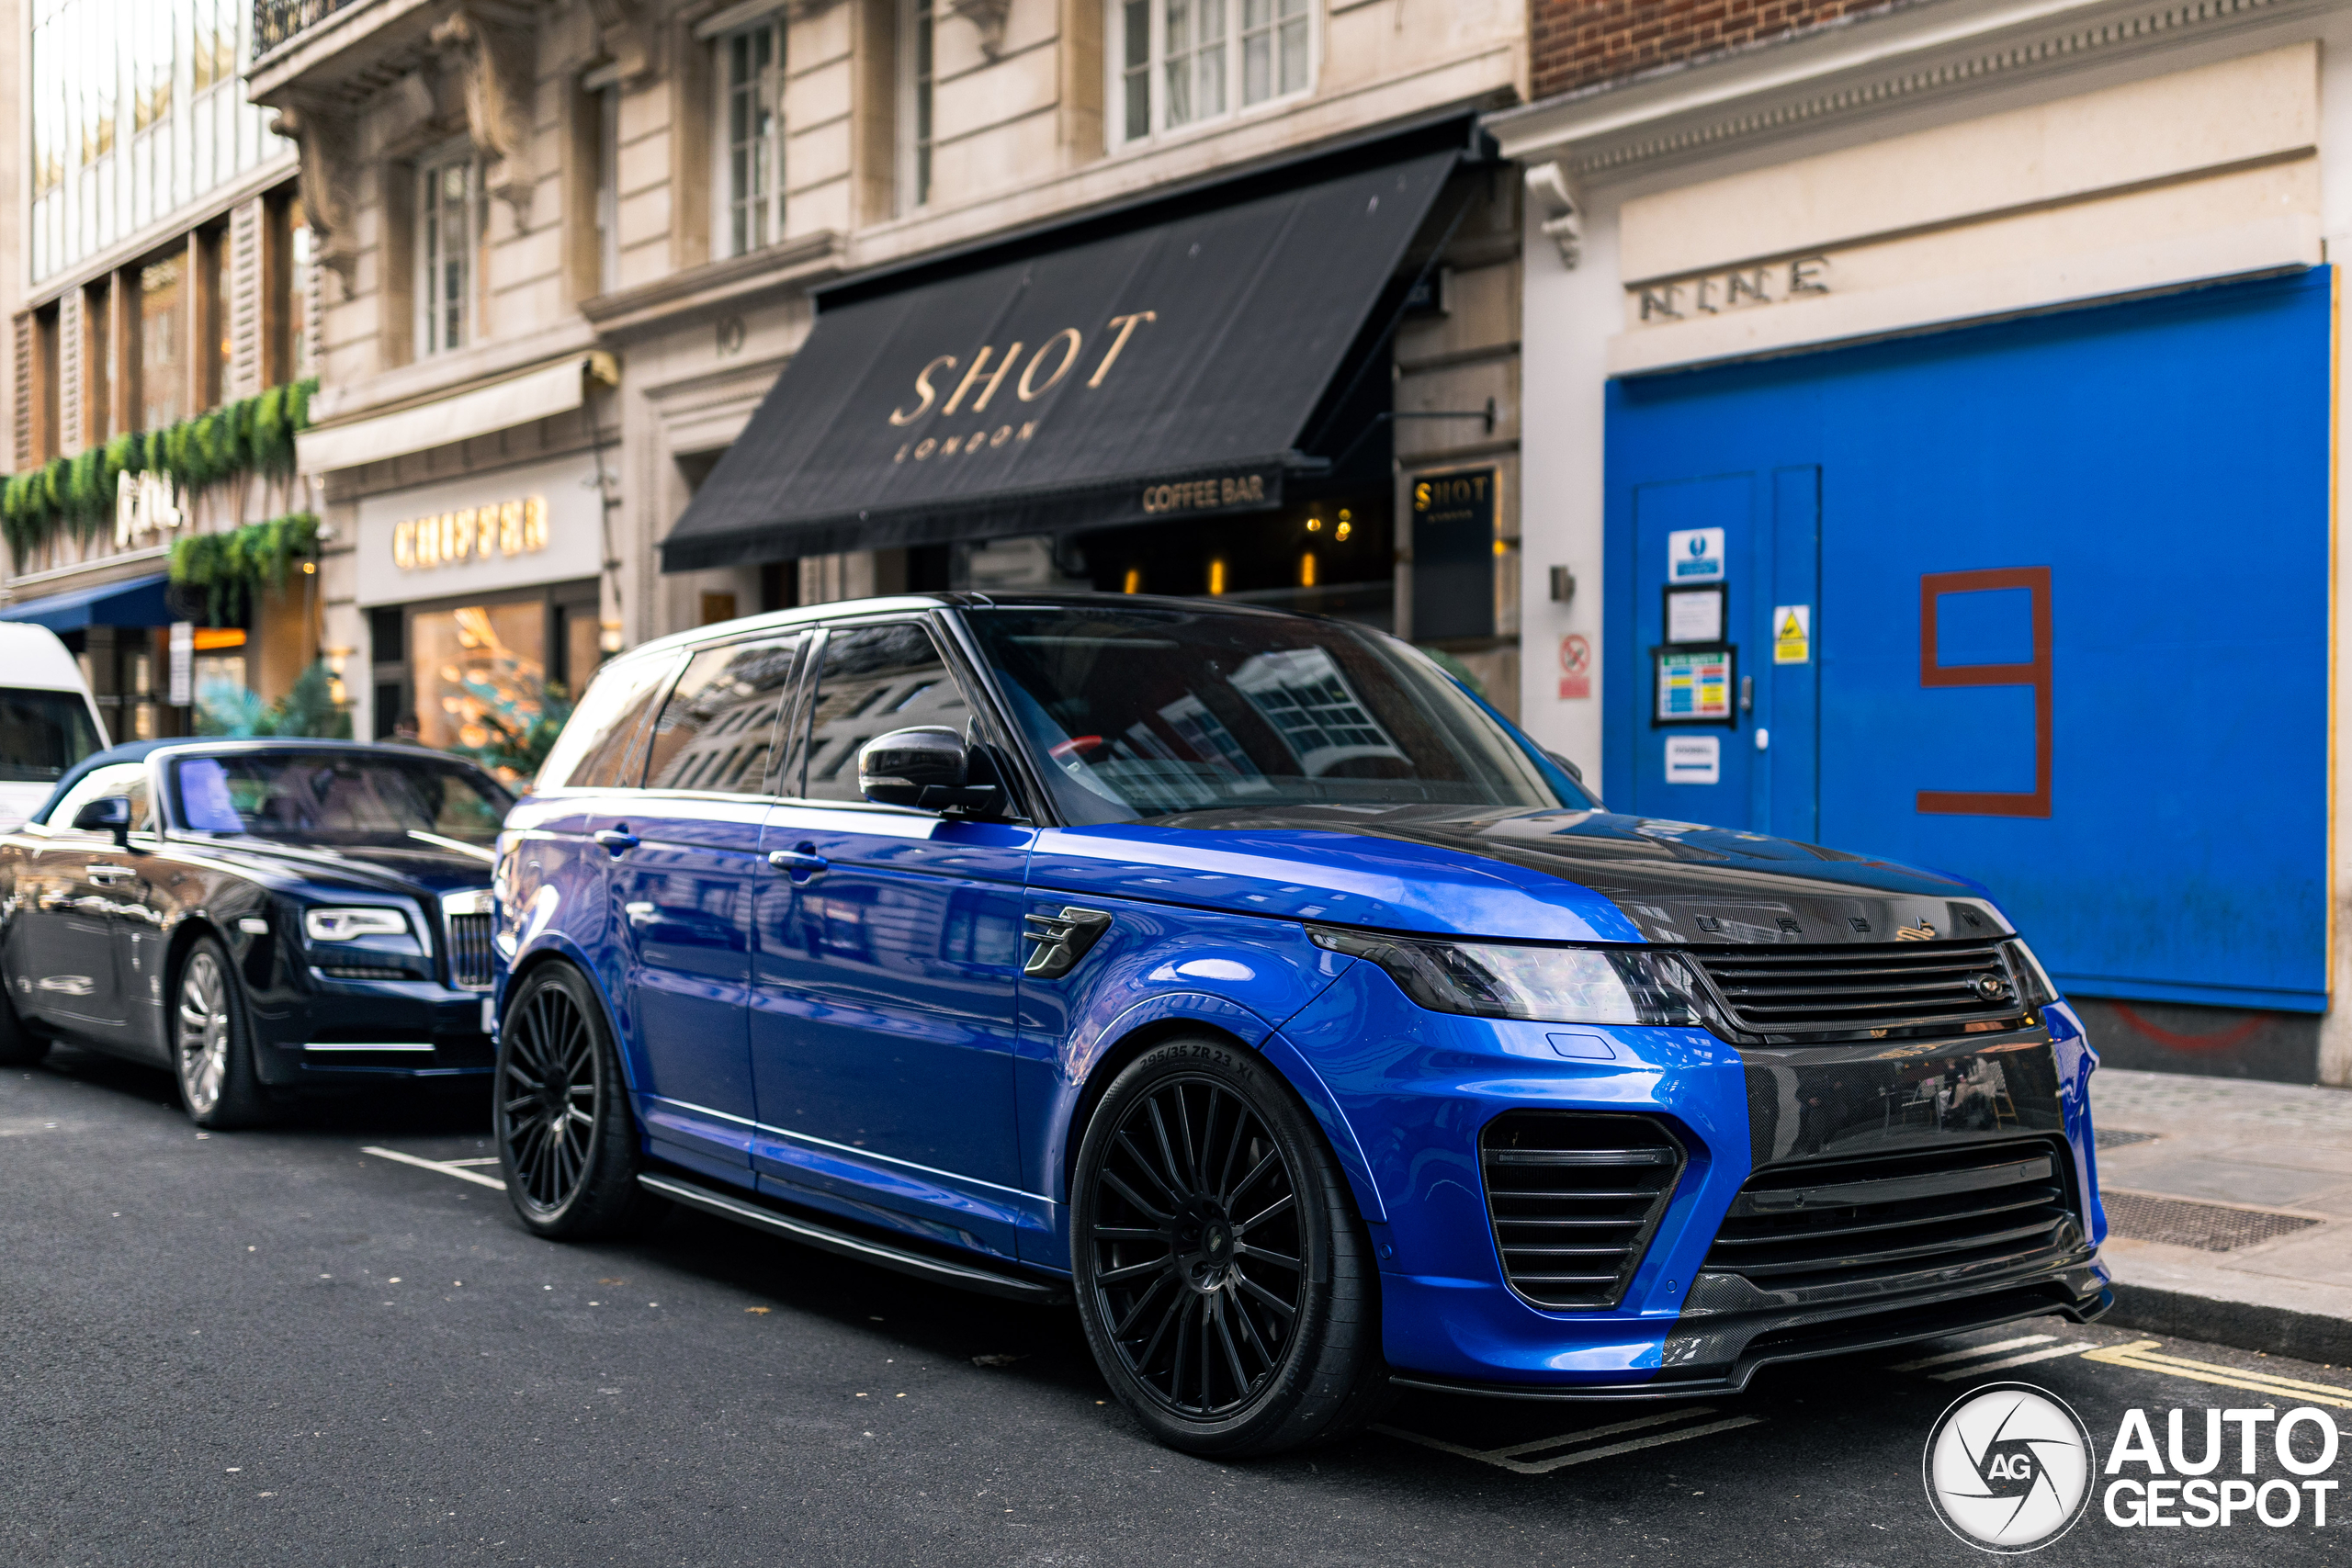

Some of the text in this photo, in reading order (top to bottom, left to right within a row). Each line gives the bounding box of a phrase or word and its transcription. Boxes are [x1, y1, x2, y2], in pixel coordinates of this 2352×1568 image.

[1640, 255, 1829, 321] NINE
[888, 310, 1157, 425] SHOT
[894, 420, 1040, 464] LONDON
[1143, 474, 1264, 514] COFFEE BAR
[1415, 476, 1487, 512] SHOT
[1917, 566, 2052, 819] 9
[1695, 912, 1982, 933] URBAN
[1139, 1045, 1255, 1085] 295/35 ZR 23 XL
